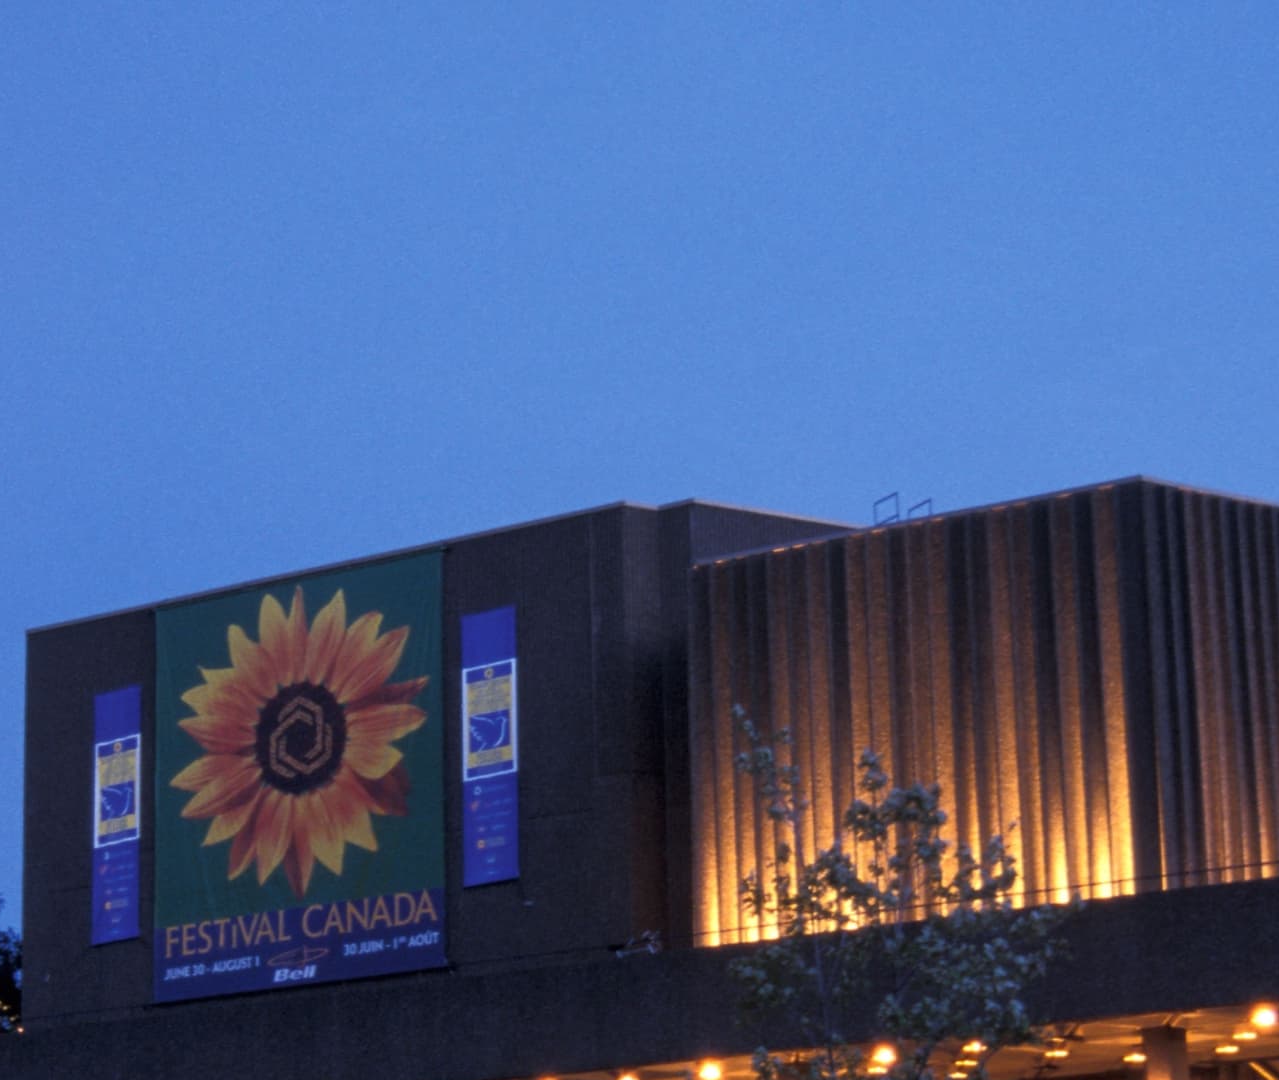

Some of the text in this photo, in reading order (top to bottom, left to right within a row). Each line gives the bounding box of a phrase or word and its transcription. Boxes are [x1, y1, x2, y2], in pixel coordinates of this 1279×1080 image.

[165, 889, 439, 958] FESTIVAL CANADA
[343, 943, 357, 956] 30
[358, 939, 385, 954] JUIN
[163, 965, 190, 981] JUNE
[191, 962, 205, 976] 30
[211, 956, 252, 973] AUGUST
[273, 964, 317, 982] Bell
